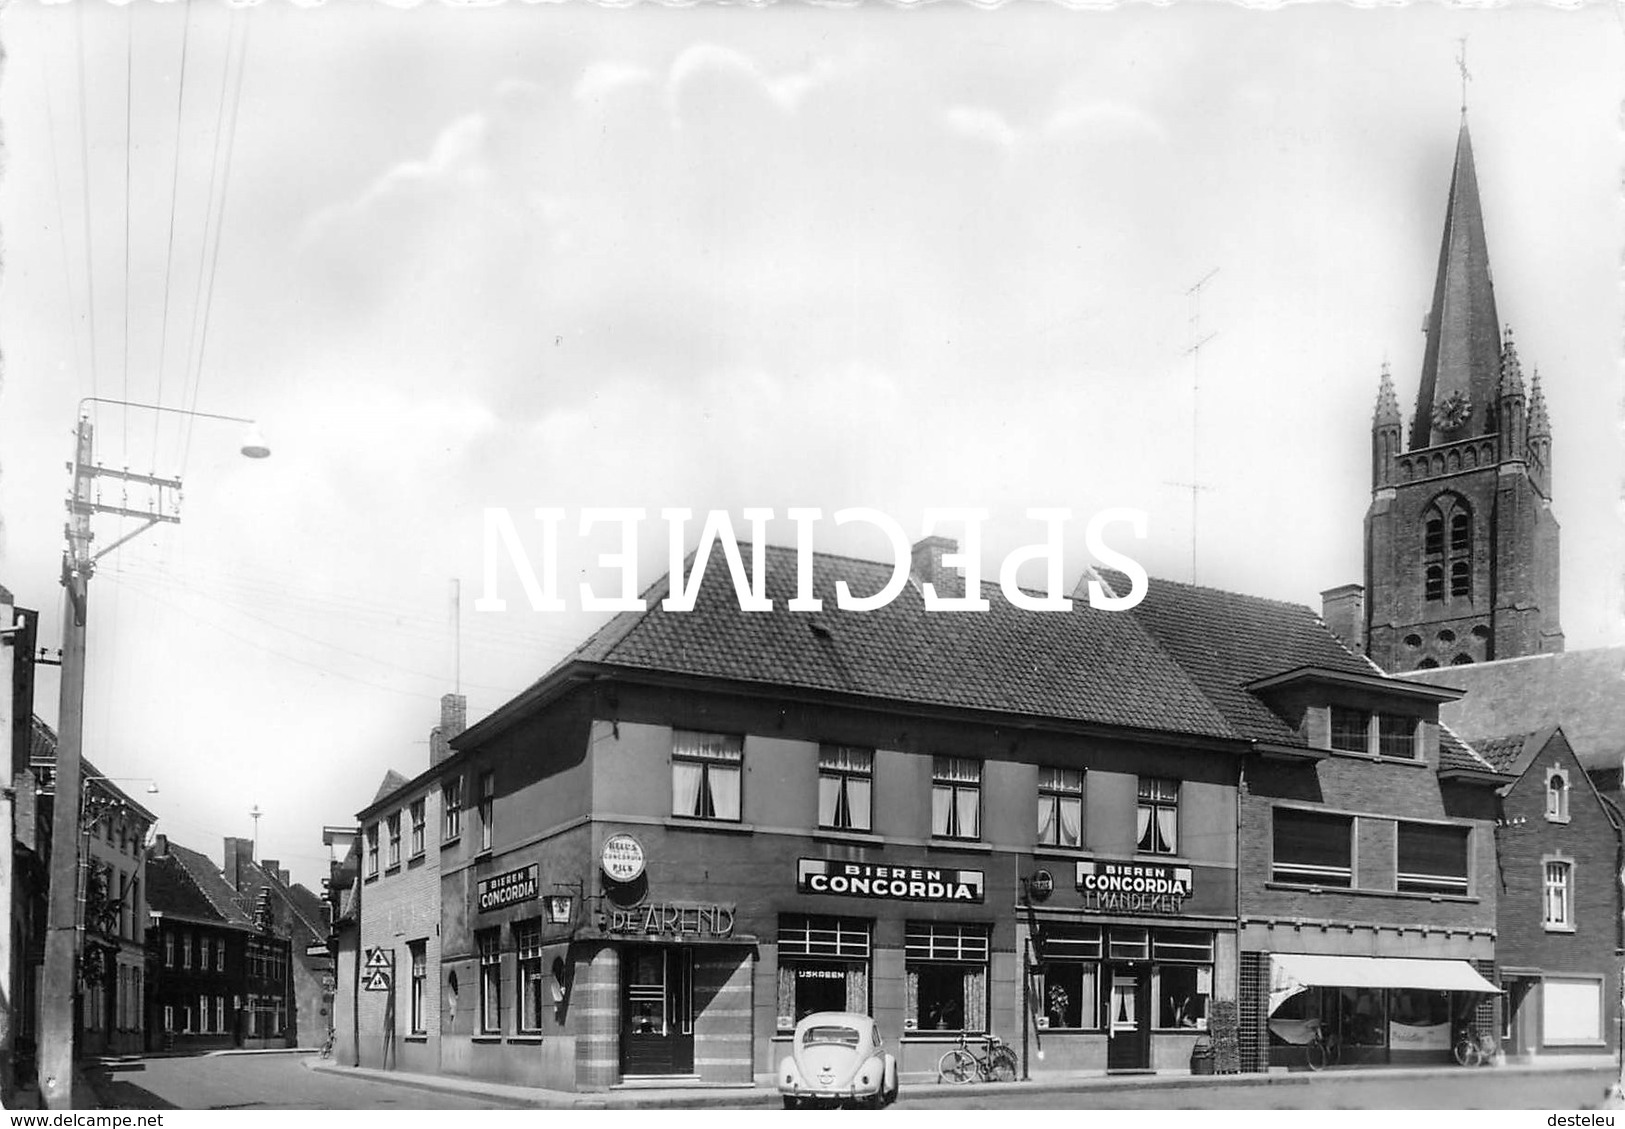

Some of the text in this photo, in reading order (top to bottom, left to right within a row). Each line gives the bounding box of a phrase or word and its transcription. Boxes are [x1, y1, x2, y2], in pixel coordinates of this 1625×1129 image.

[612, 863, 633, 872] PILS
[845, 865, 940, 880] BIEREN
[1106, 865, 1165, 877] BIEREN
[491, 871, 524, 889] BIEREN
[811, 875, 972, 899] CONCORDIA
[1085, 875, 1184, 894] CONCORDIA
[481, 880, 534, 908] CONCORDIA
[612, 903, 733, 934] DE AREND
